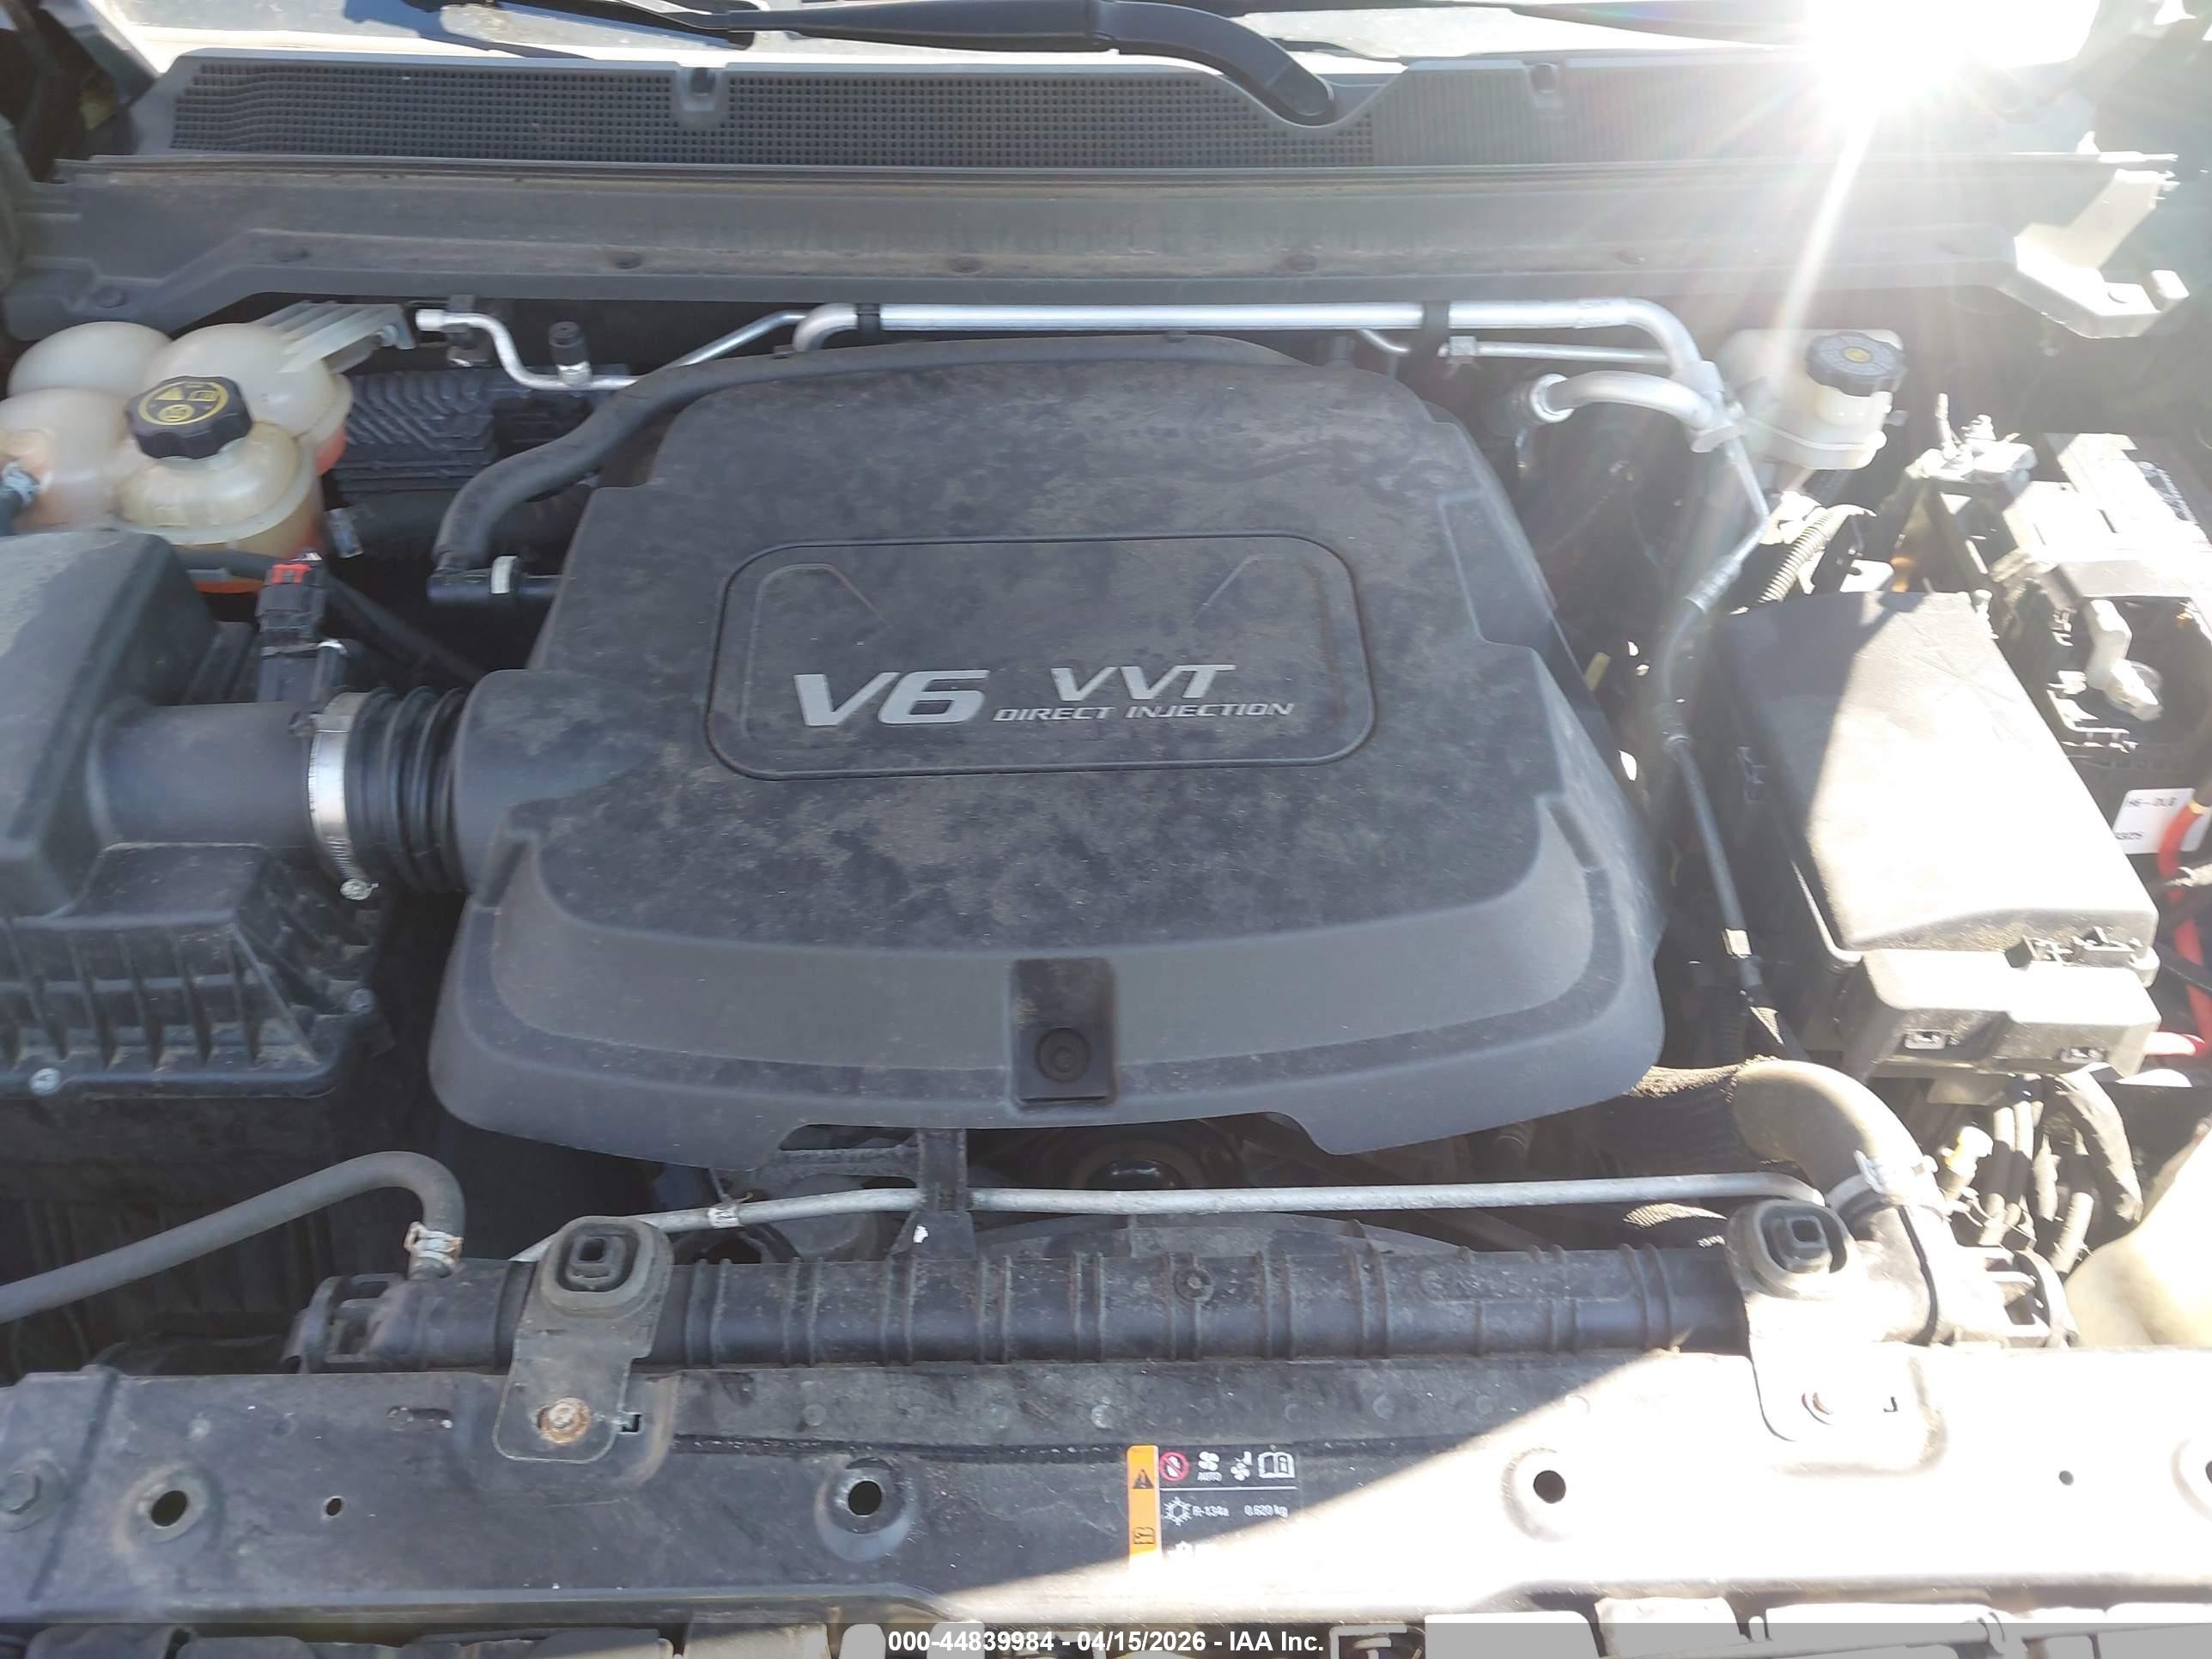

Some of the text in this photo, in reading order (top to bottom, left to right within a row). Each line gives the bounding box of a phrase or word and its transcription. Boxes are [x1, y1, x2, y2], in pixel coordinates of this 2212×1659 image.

[794, 670, 989, 726] V6
[1052, 665, 1237, 702] VVT
[993, 702, 1295, 721] DIRECT INJECTION
